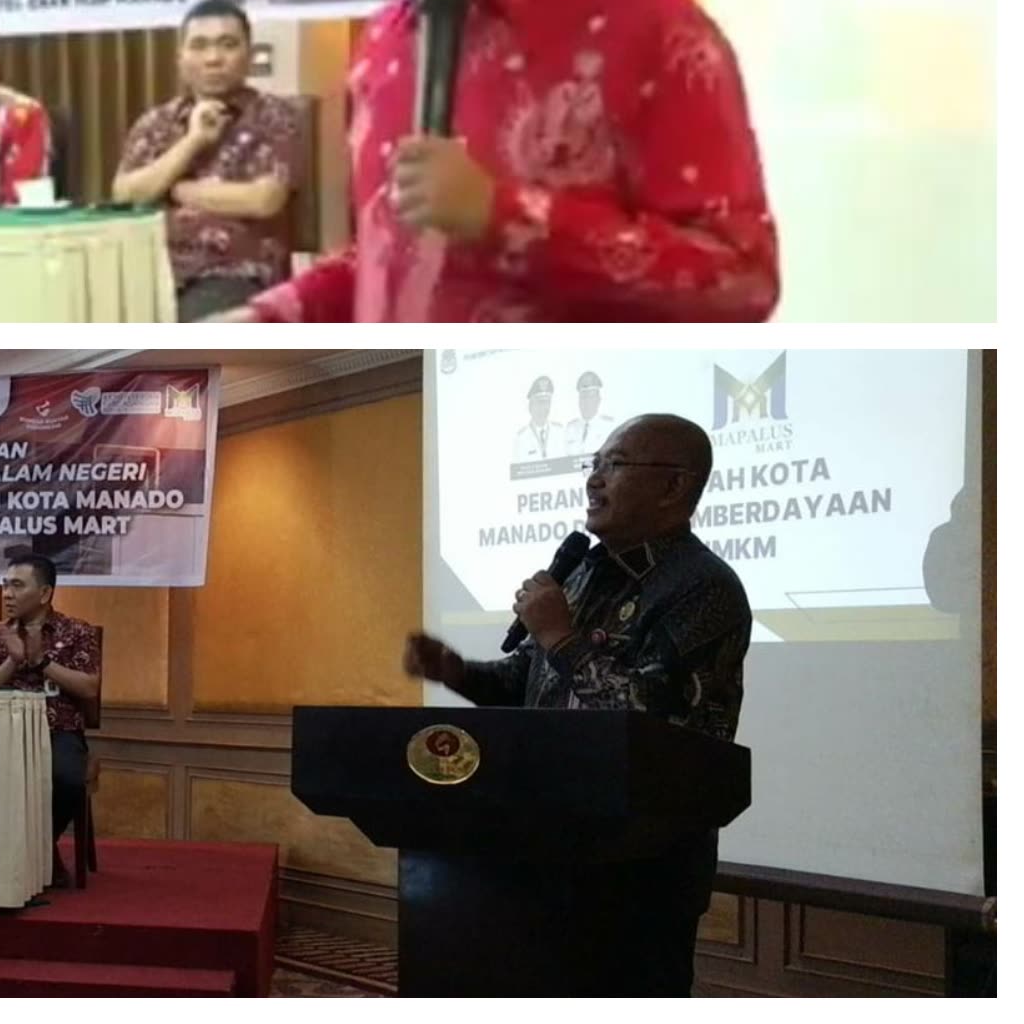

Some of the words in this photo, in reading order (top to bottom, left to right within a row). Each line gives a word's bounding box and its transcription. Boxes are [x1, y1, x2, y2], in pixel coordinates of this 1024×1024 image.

[711, 423, 794, 448] MAPALUS
[756, 439, 794, 454] MART
[58, 462, 148, 482] NEGERI
[750, 457, 831, 489] KOTA
[7, 490, 70, 510] KOTA
[77, 489, 184, 510] MANADO
[516, 486, 584, 514] PERAN
[690, 487, 892, 529] MBERDAYAAN
[63, 515, 132, 536] MART
[478, 520, 569, 548] MANADO
[706, 535, 777, 561] MKM
